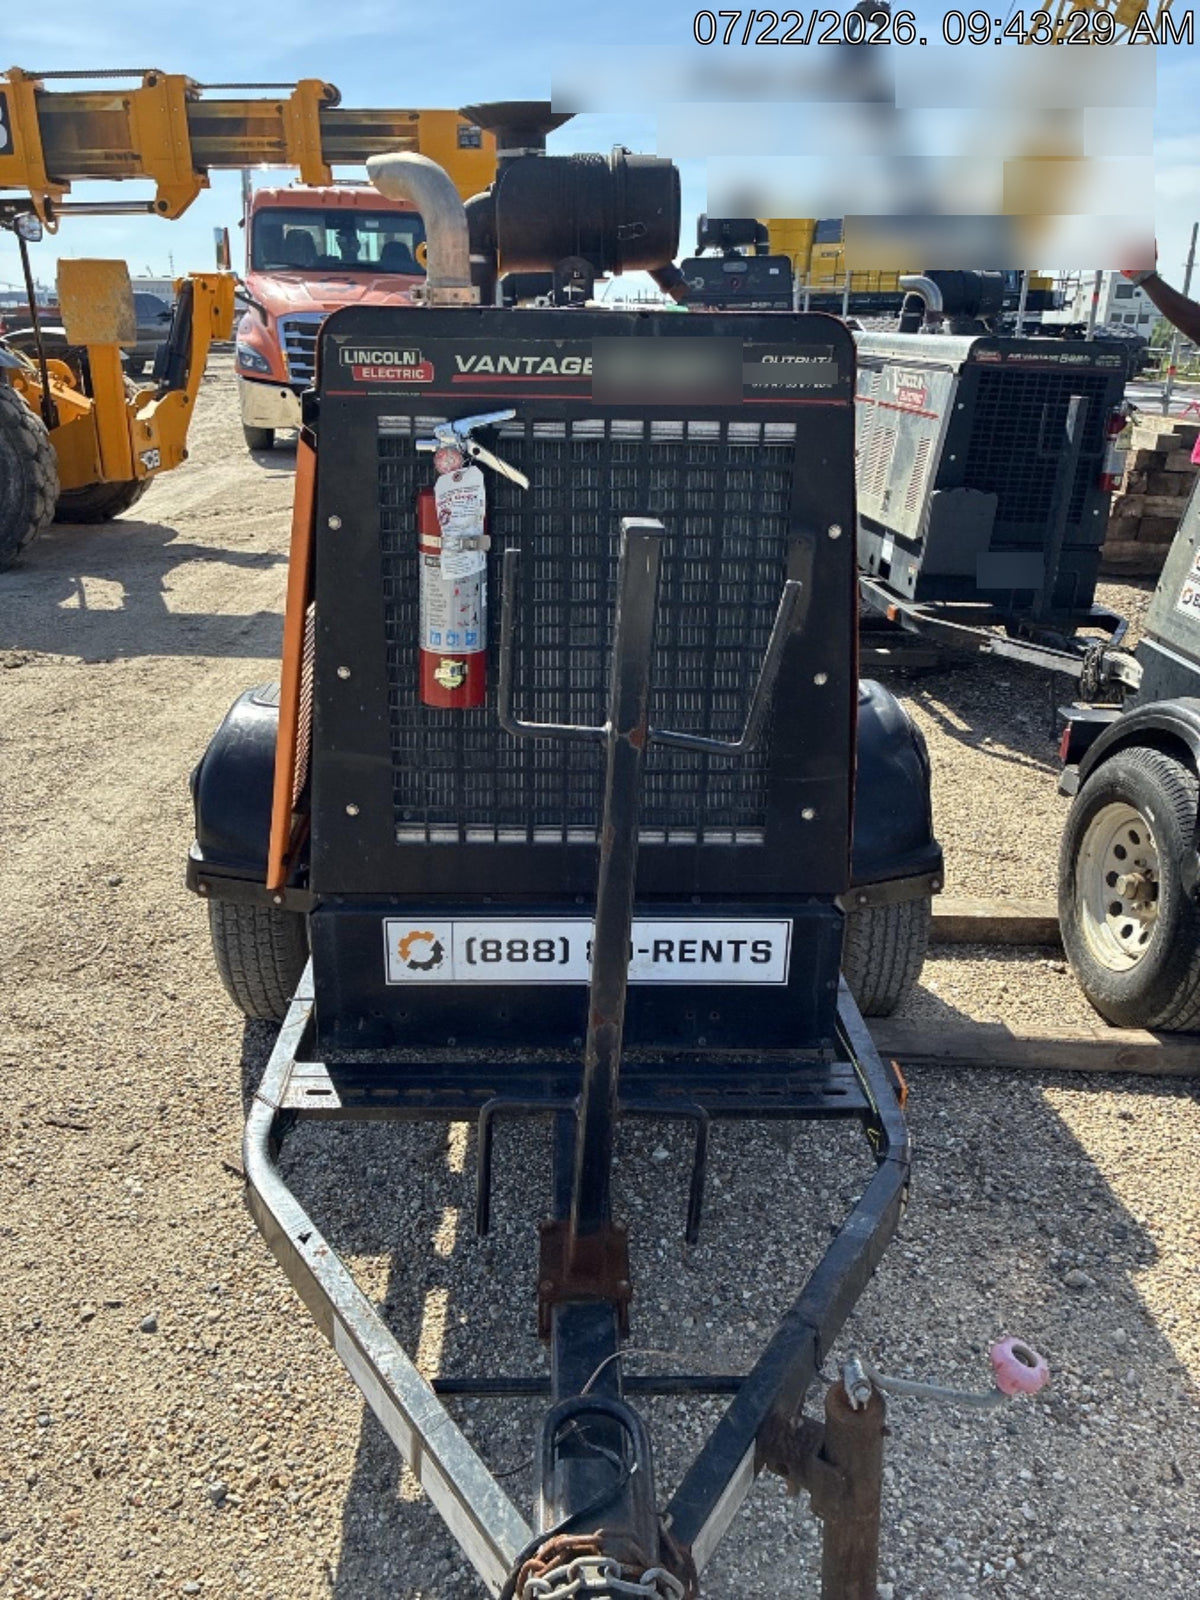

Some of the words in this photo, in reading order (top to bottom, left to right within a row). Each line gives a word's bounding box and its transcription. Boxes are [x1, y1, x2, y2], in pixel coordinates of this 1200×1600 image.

[344, 350, 416, 365] LINCOLN
[362, 367, 425, 379] ELECTRIC
[465, 936, 570, 965] (888)
[586, 938, 773, 965] -RENTS
